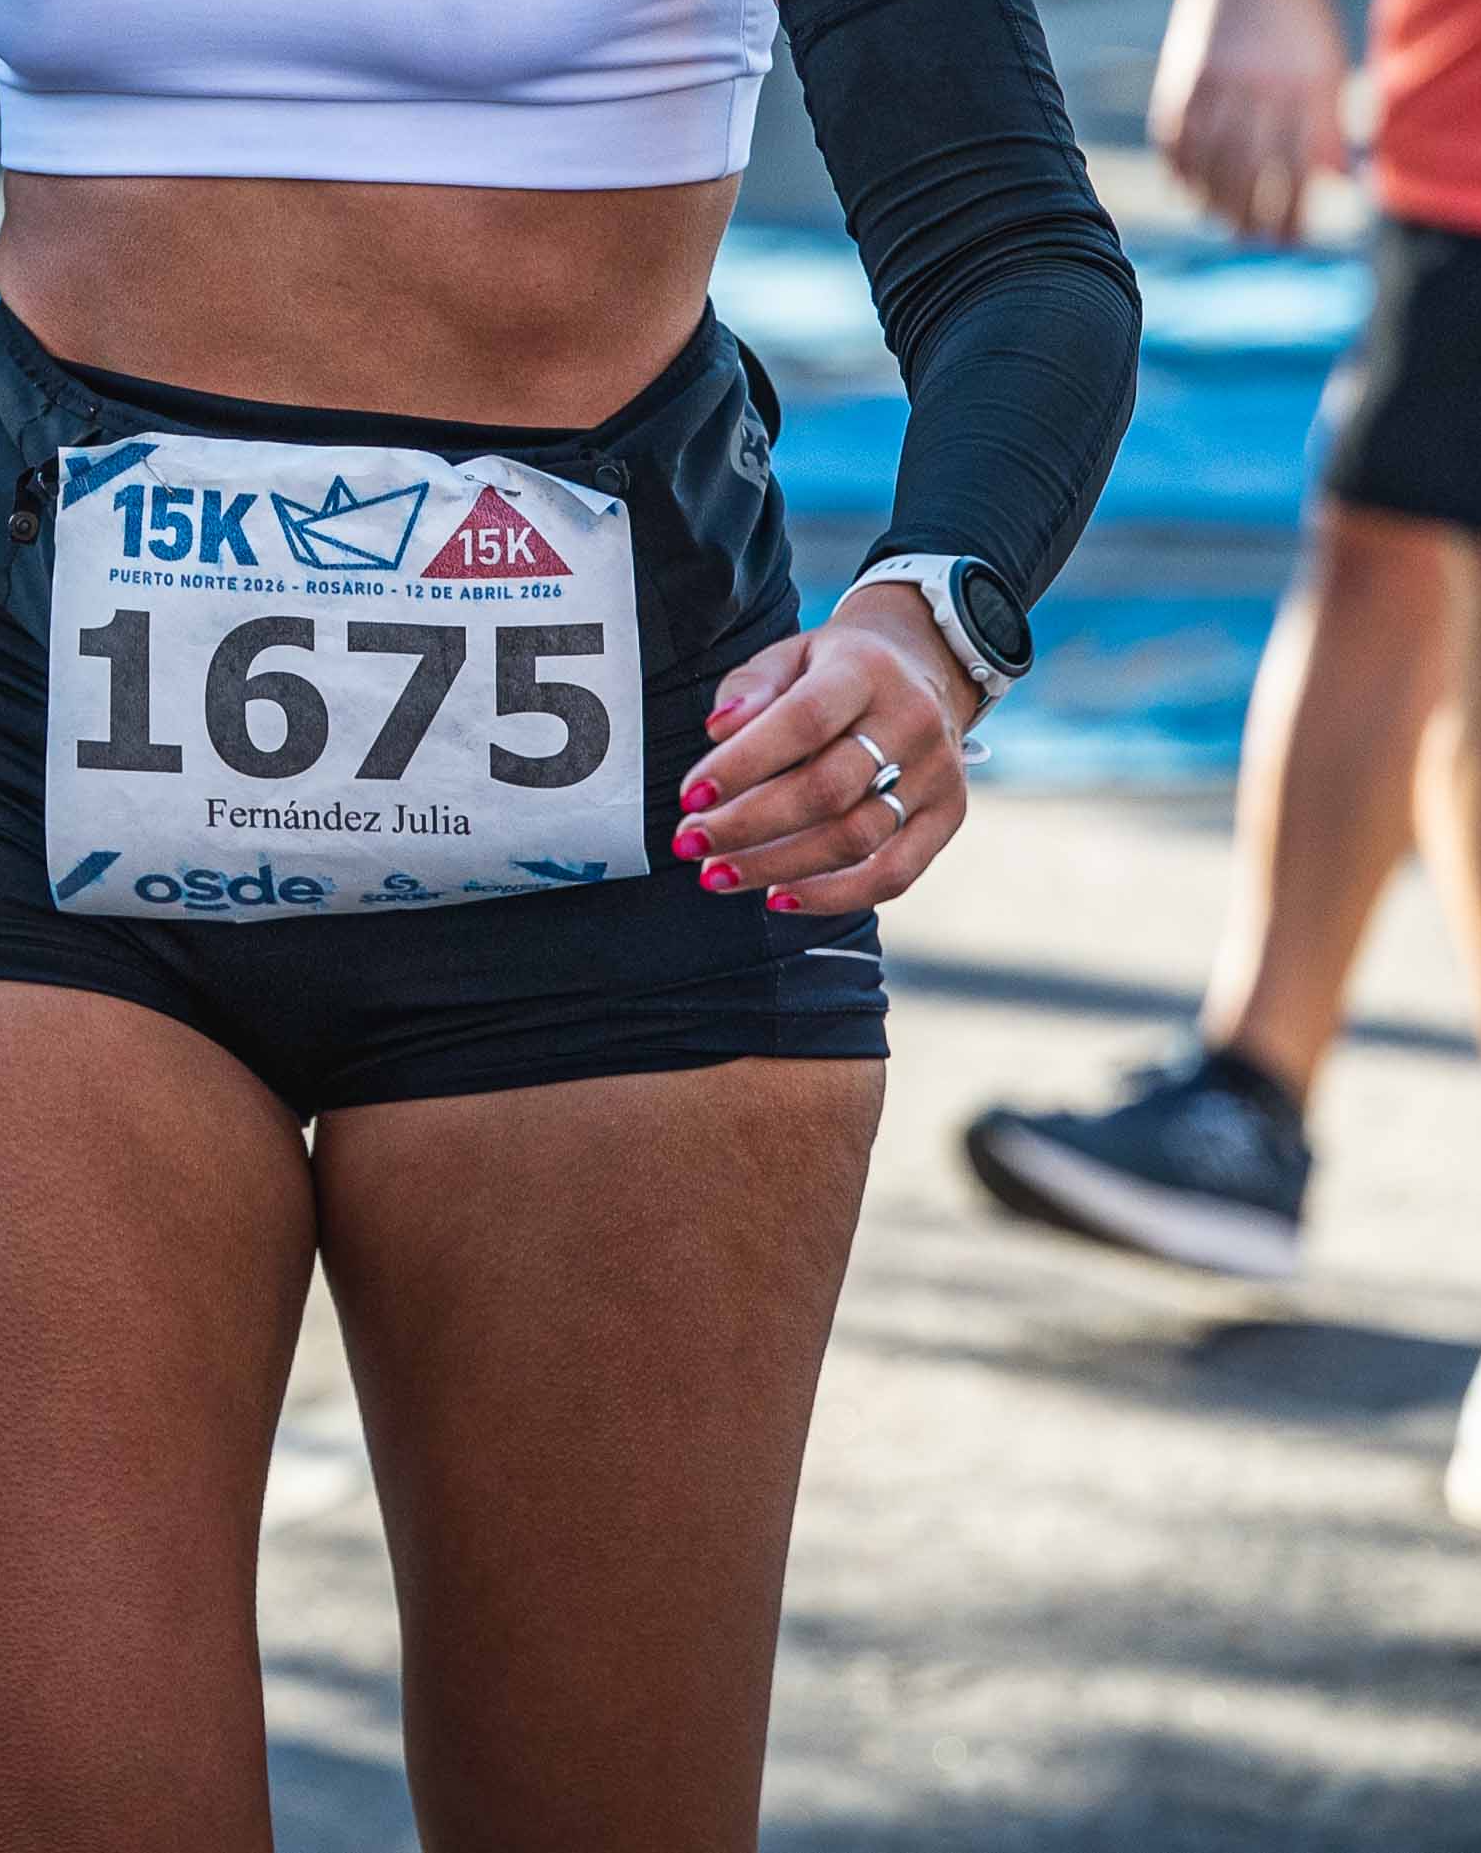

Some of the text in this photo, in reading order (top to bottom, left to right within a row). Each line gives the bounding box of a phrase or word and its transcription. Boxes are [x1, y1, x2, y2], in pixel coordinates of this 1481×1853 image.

[113, 484, 259, 567] 15K
[458, 527, 537, 566] 15K
[109, 568, 174, 586] PUERTO
[180, 575, 237, 591] NORTE
[243, 578, 285, 594] 2026
[306, 580, 384, 596] ROSARIO
[405, 584, 424, 598] 12
[432, 585, 453, 599] DE
[460, 585, 513, 600] ABRIL
[521, 583, 562, 599] 2026
[76, 608, 611, 789] 1675
[205, 798, 471, 836] Fernández Julia
[134, 864, 325, 908] osde
